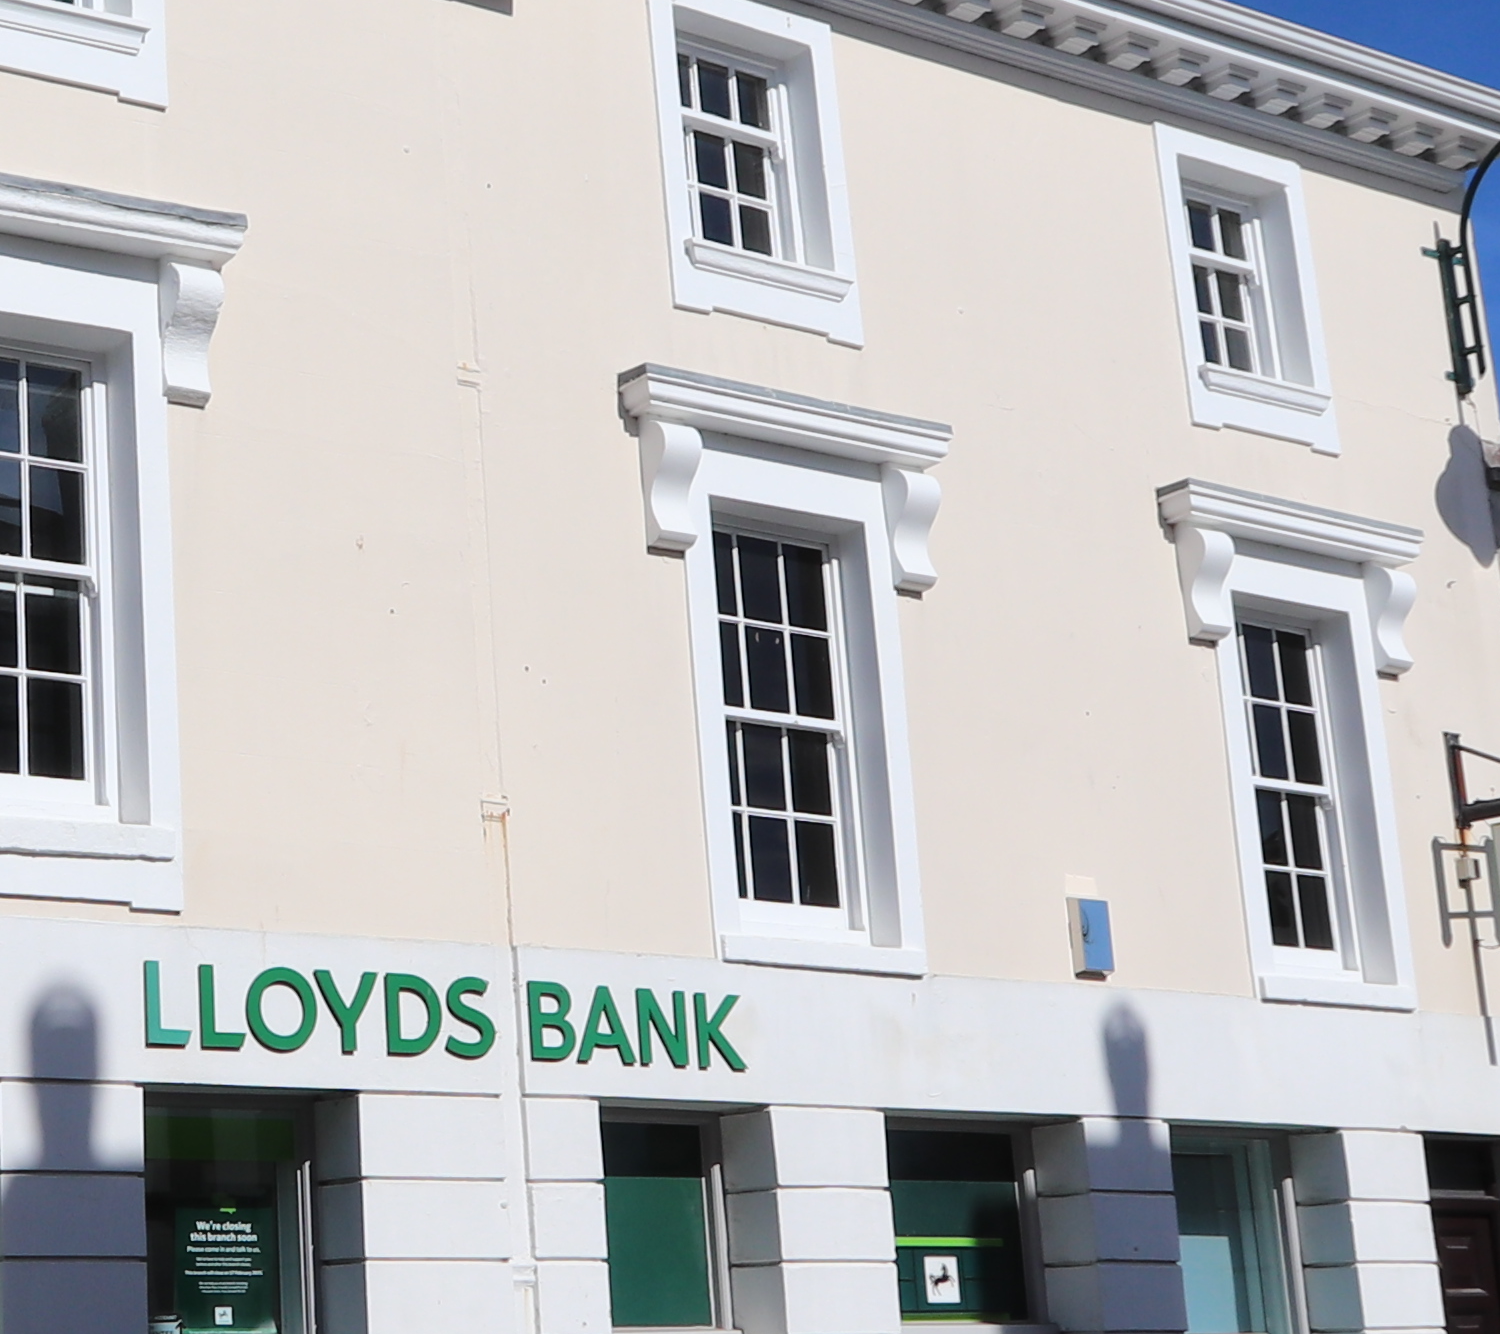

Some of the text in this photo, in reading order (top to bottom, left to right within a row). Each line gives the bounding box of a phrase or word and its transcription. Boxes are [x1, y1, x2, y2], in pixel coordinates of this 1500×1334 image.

[143, 960, 749, 1072] LLOYDS BANK
[196, 1221, 252, 1233] We're closing
[190, 1232, 258, 1242] this branch soon
